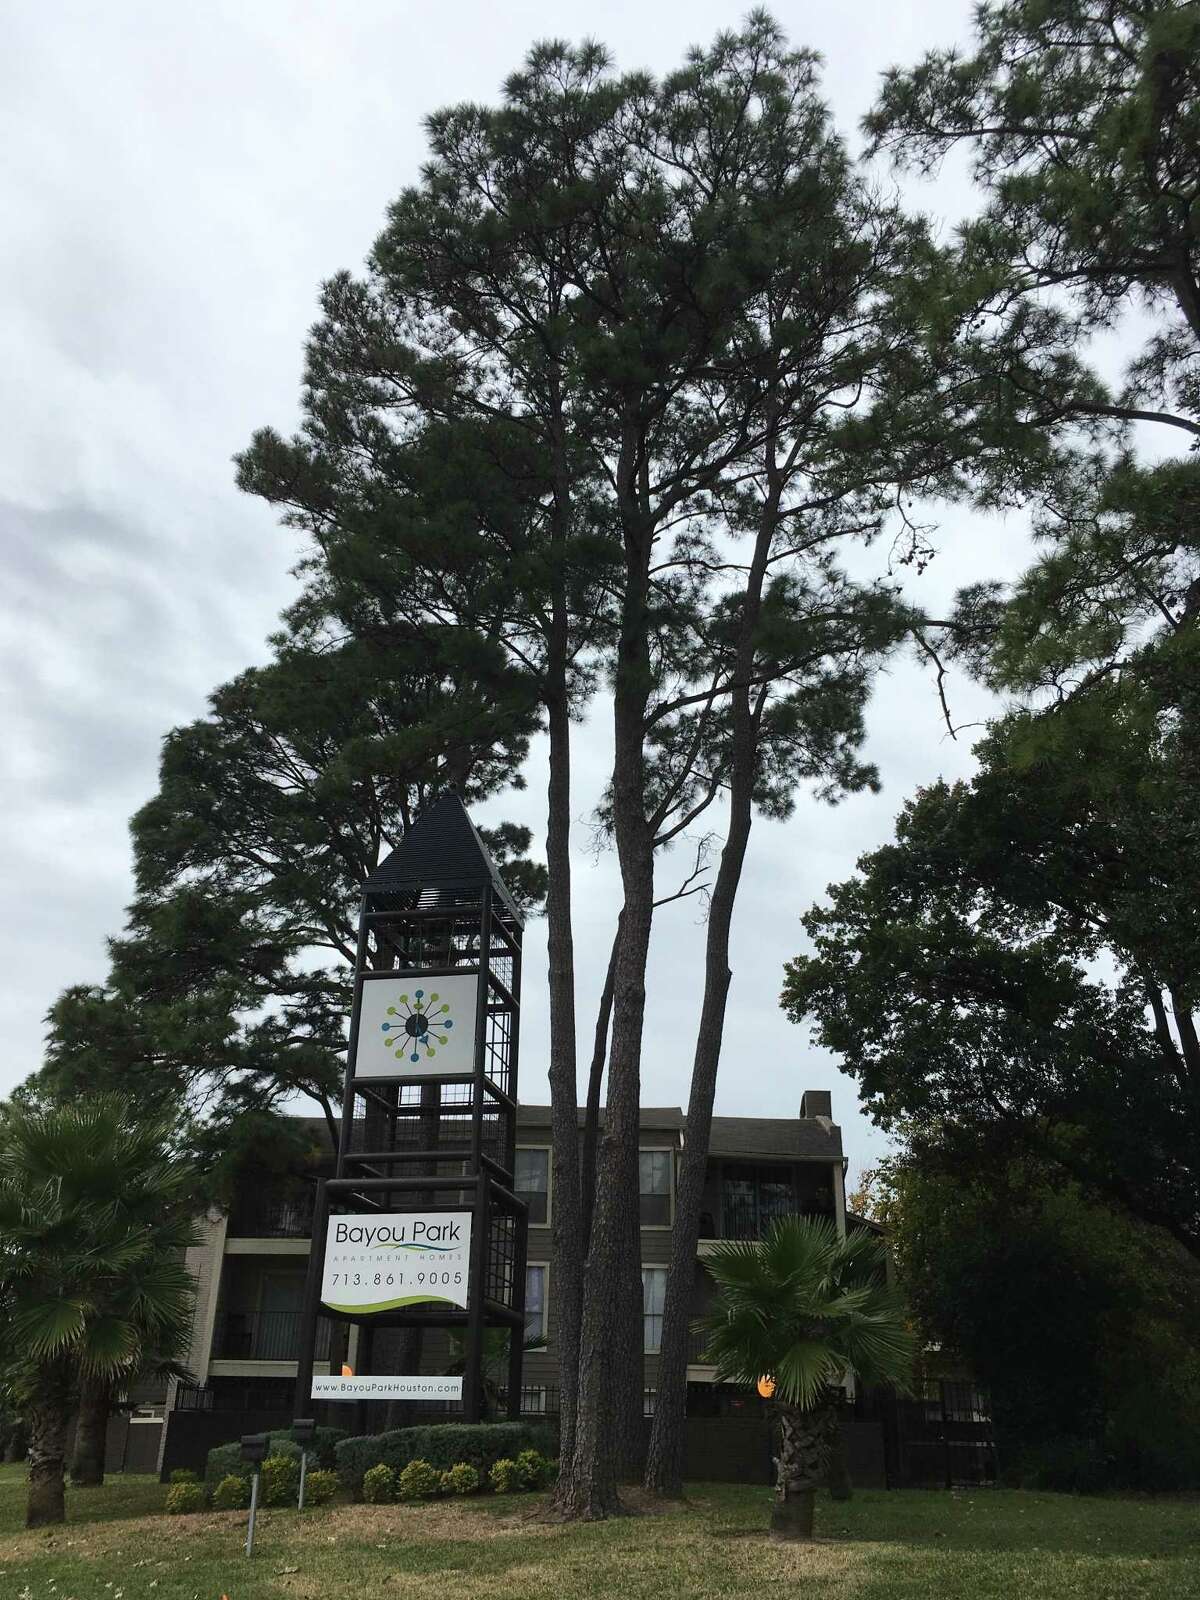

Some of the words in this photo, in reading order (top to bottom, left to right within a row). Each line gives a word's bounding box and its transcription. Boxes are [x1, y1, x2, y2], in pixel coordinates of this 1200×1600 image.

[335, 1223, 405, 1247] Bayou
[412, 1221, 461, 1241] Park
[333, 1254, 409, 1263] APARTMENT
[419, 1253, 463, 1262] HOMES
[332, 1272, 462, 1286] 713.861.9005
[315, 1382, 459, 1393] www.BayouParkHouston.com
